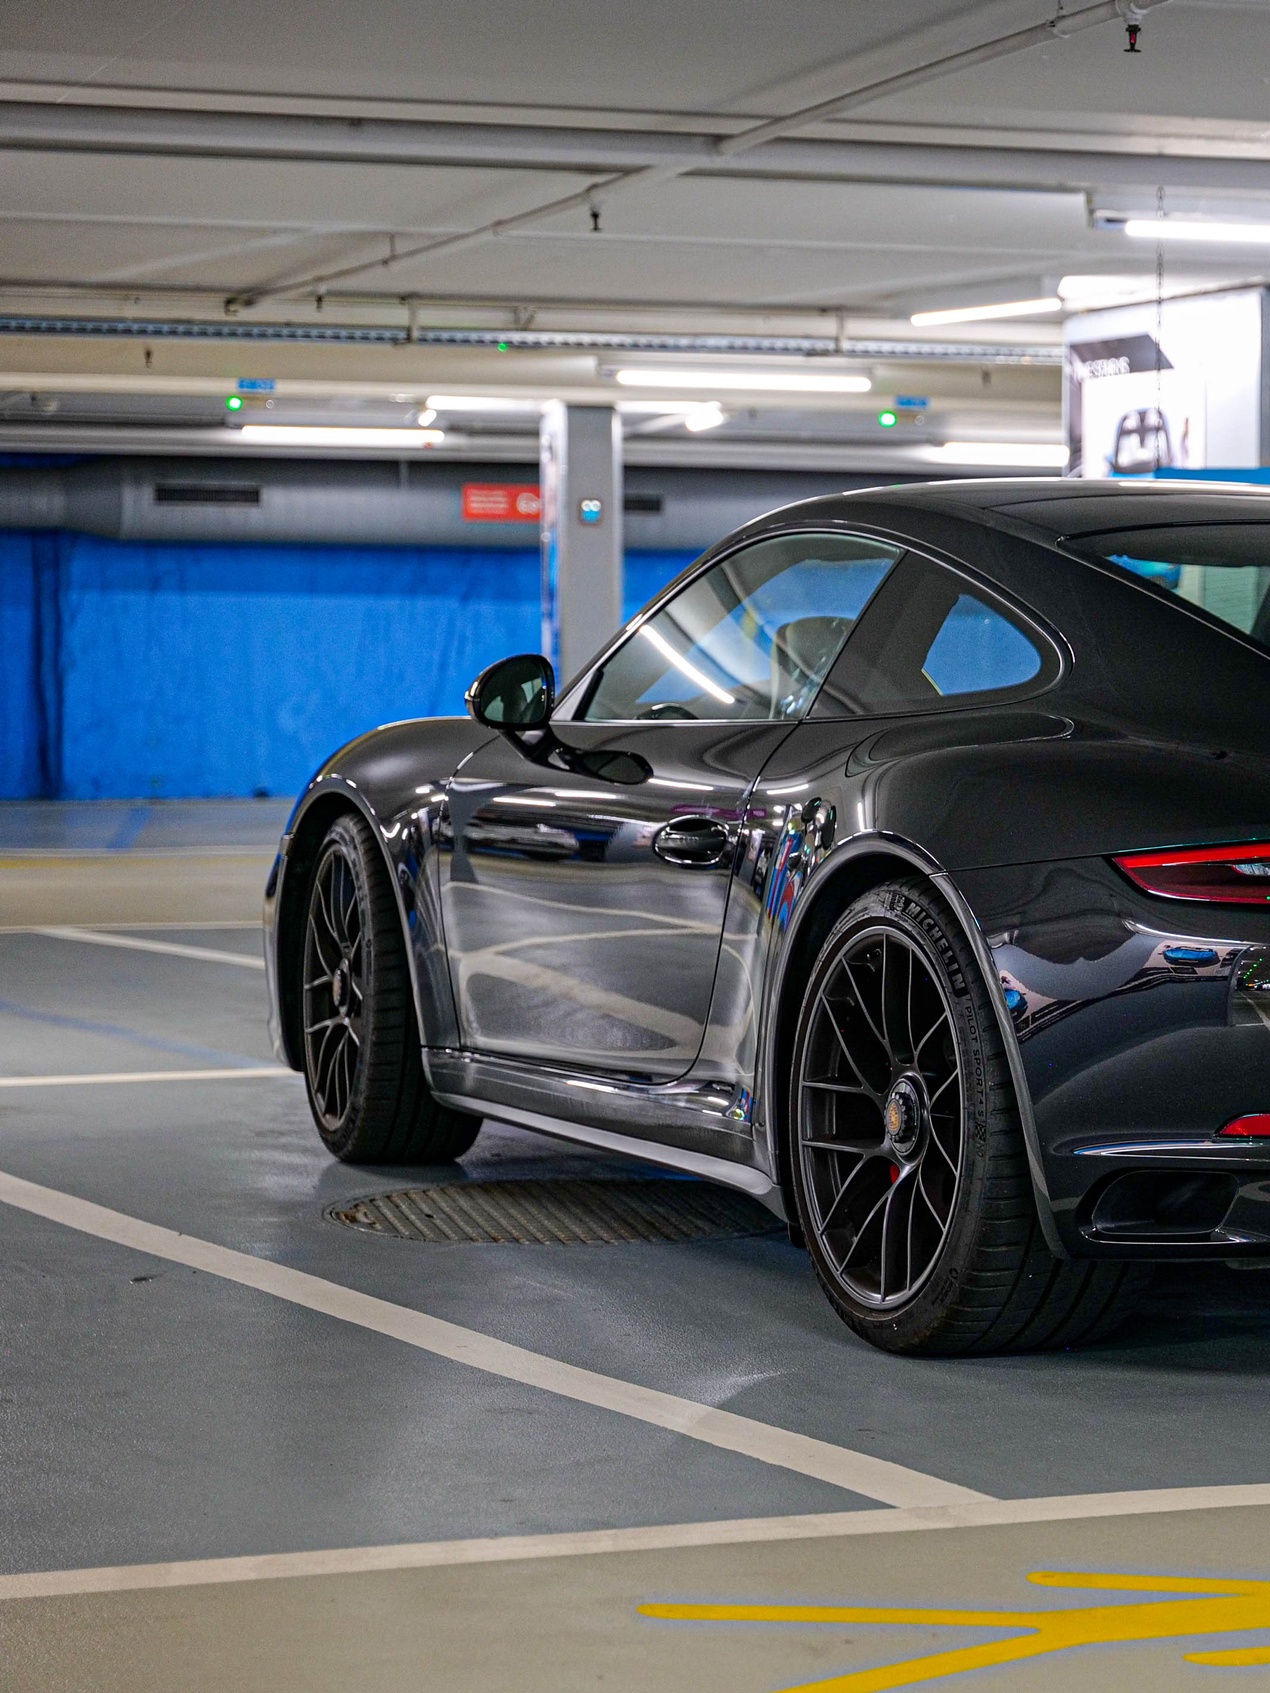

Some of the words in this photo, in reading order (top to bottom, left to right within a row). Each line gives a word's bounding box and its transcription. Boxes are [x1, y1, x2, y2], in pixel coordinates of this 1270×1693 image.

[905, 902, 966, 990] MICHELIN
[964, 1006, 979, 1043] PILOT
[972, 1049, 984, 1099] SPORT
